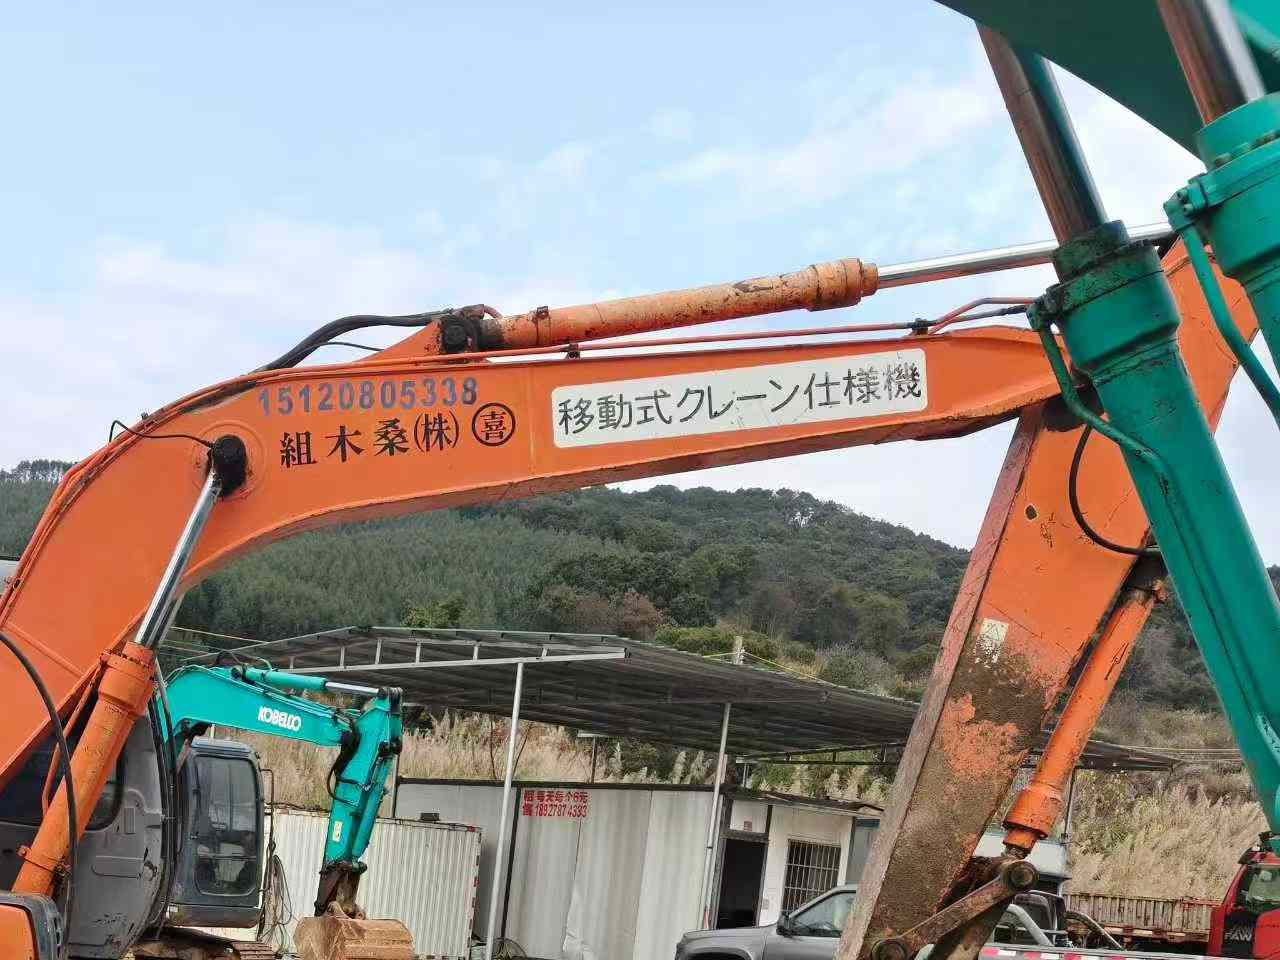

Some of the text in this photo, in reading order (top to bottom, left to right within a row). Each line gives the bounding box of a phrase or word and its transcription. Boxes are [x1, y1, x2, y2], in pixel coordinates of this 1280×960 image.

[258, 376, 477, 416] 15120805338
[558, 363, 921, 435] 移動式クレーン仕様機
[258, 706, 301, 731] KOBELCO
